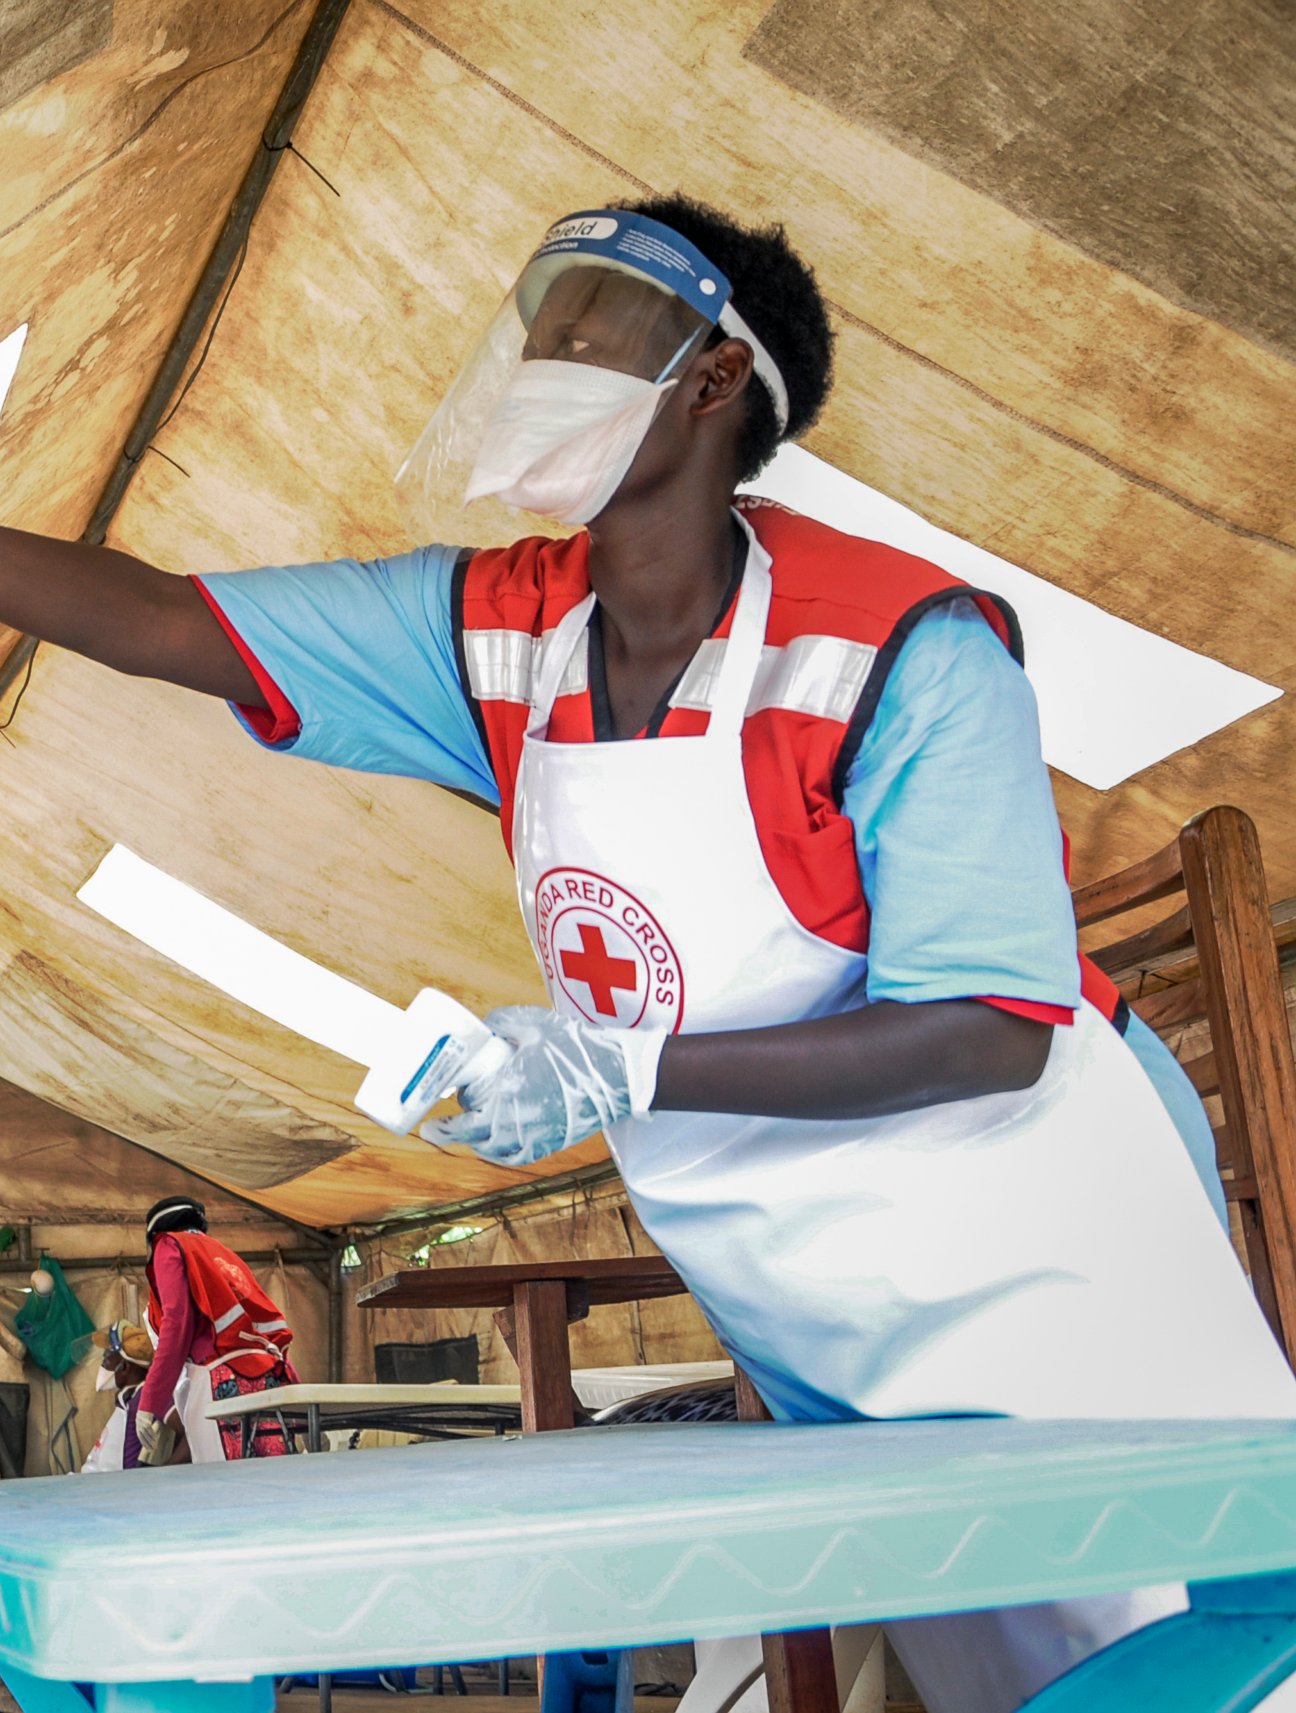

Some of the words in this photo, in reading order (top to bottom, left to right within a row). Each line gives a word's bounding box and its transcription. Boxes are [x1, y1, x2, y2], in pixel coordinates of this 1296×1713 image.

[540, 883, 565, 979] UGANDA
[565, 879, 614, 908] RED
[622, 906, 674, 1006] CROSS
